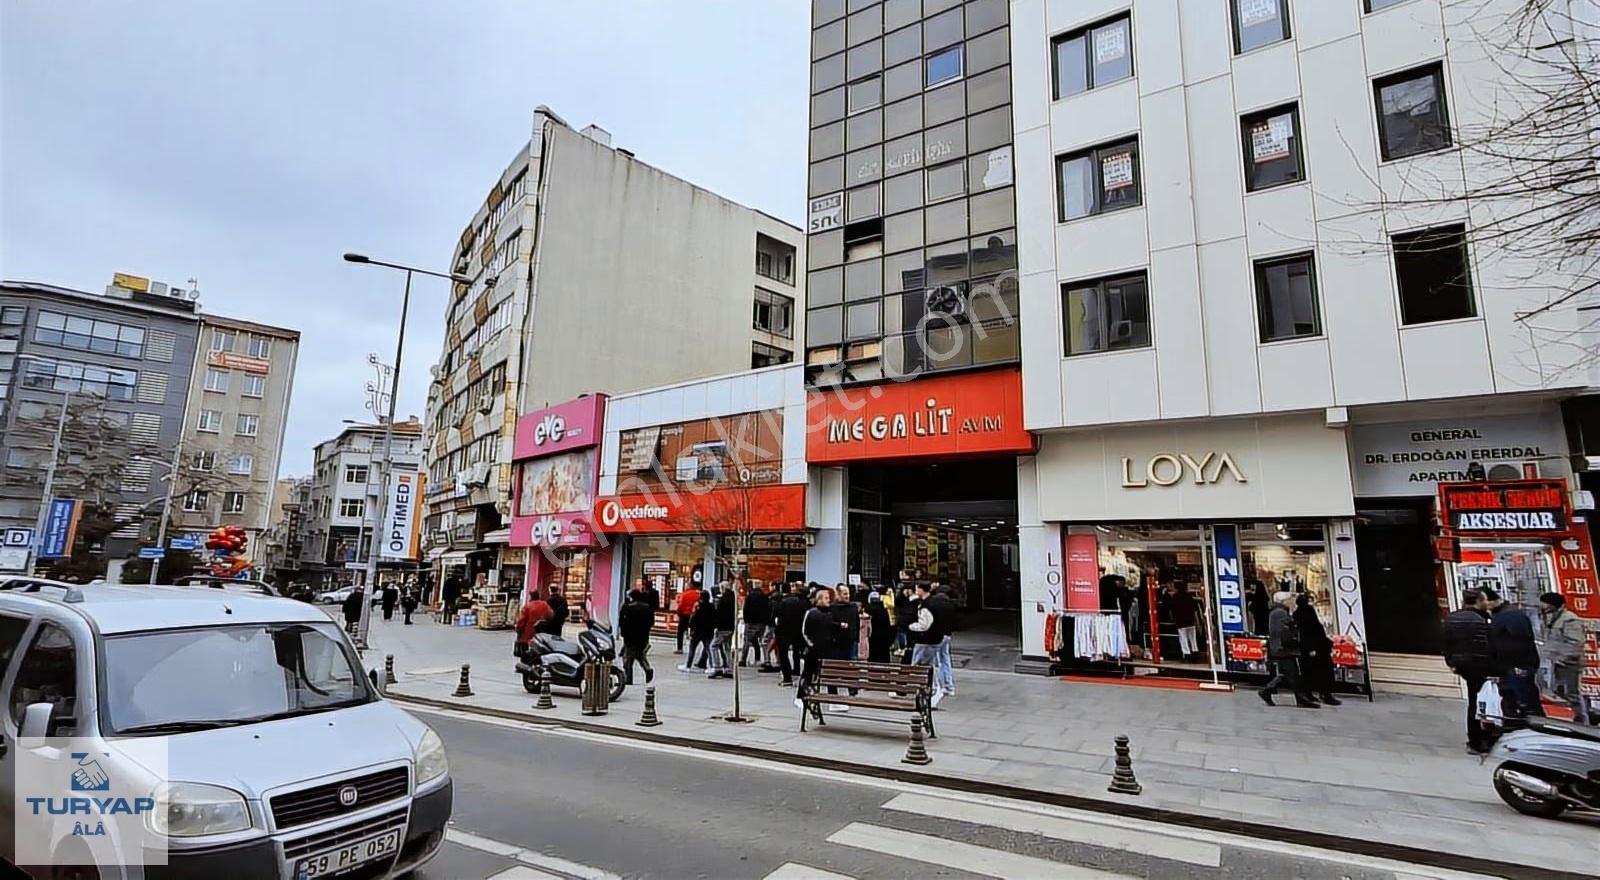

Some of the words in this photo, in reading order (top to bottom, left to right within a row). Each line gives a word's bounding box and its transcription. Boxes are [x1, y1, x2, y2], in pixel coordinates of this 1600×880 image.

[959, 415, 1002, 433] AVM
[1410, 429, 1482, 442] GENERAL
[1365, 454, 1389, 464] DR.
[1392, 449, 1467, 463] ERDOĞAN
[1471, 447, 1546, 460] ERERDAL
[1122, 452, 1247, 488] LOYA
[620, 504, 669, 519] vodafone
[1458, 512, 1556, 529] AKSESUAR
[1569, 554, 1590, 570] VE
[1217, 558, 1242, 624] NBB
[308, 856, 329, 876] 59
[338, 846, 359, 867] PE
[367, 834, 395, 857] 052
